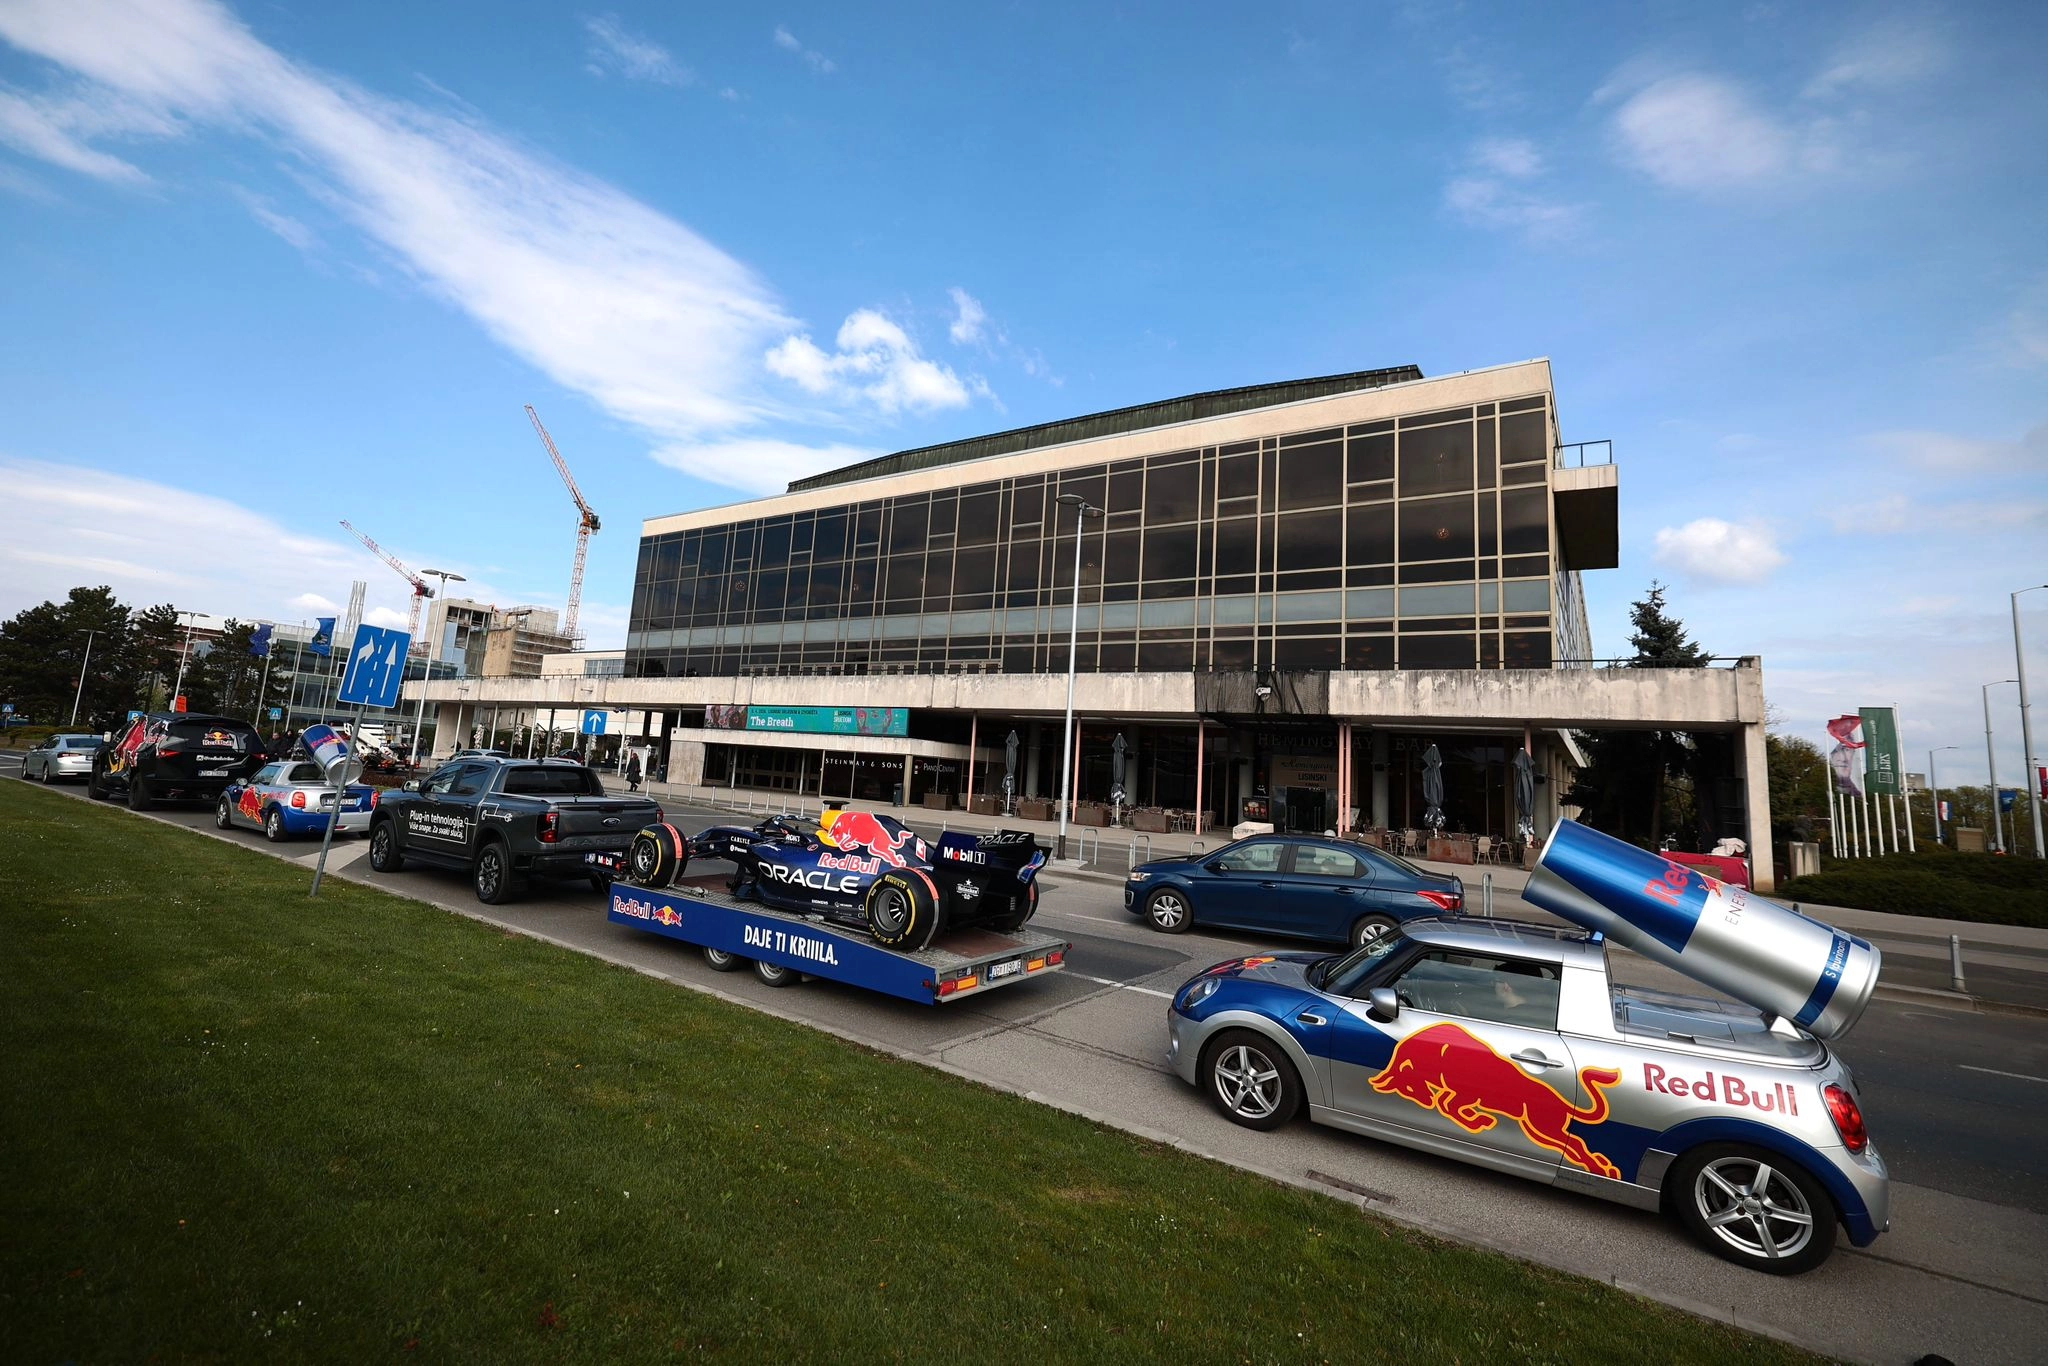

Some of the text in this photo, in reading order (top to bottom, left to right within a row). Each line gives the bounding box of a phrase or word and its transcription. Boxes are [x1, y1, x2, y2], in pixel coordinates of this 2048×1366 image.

[751, 716, 794, 727] The Breath
[1257, 733, 1374, 750] HEMINGAY
[825, 758, 866, 767] STEINWAY
[409, 810, 465, 829] Plug-in tehnologija.
[432, 825, 438, 833] Za
[817, 852, 881, 875] Red Bull
[943, 846, 973, 863] Mobil
[758, 861, 860, 895] ORACLE
[612, 896, 651, 920] Red Bull
[744, 924, 838, 966] DAJE TI KRIIILA.
[1825, 970, 1837, 979] S
[1643, 1062, 1799, 1117] Red Bull
